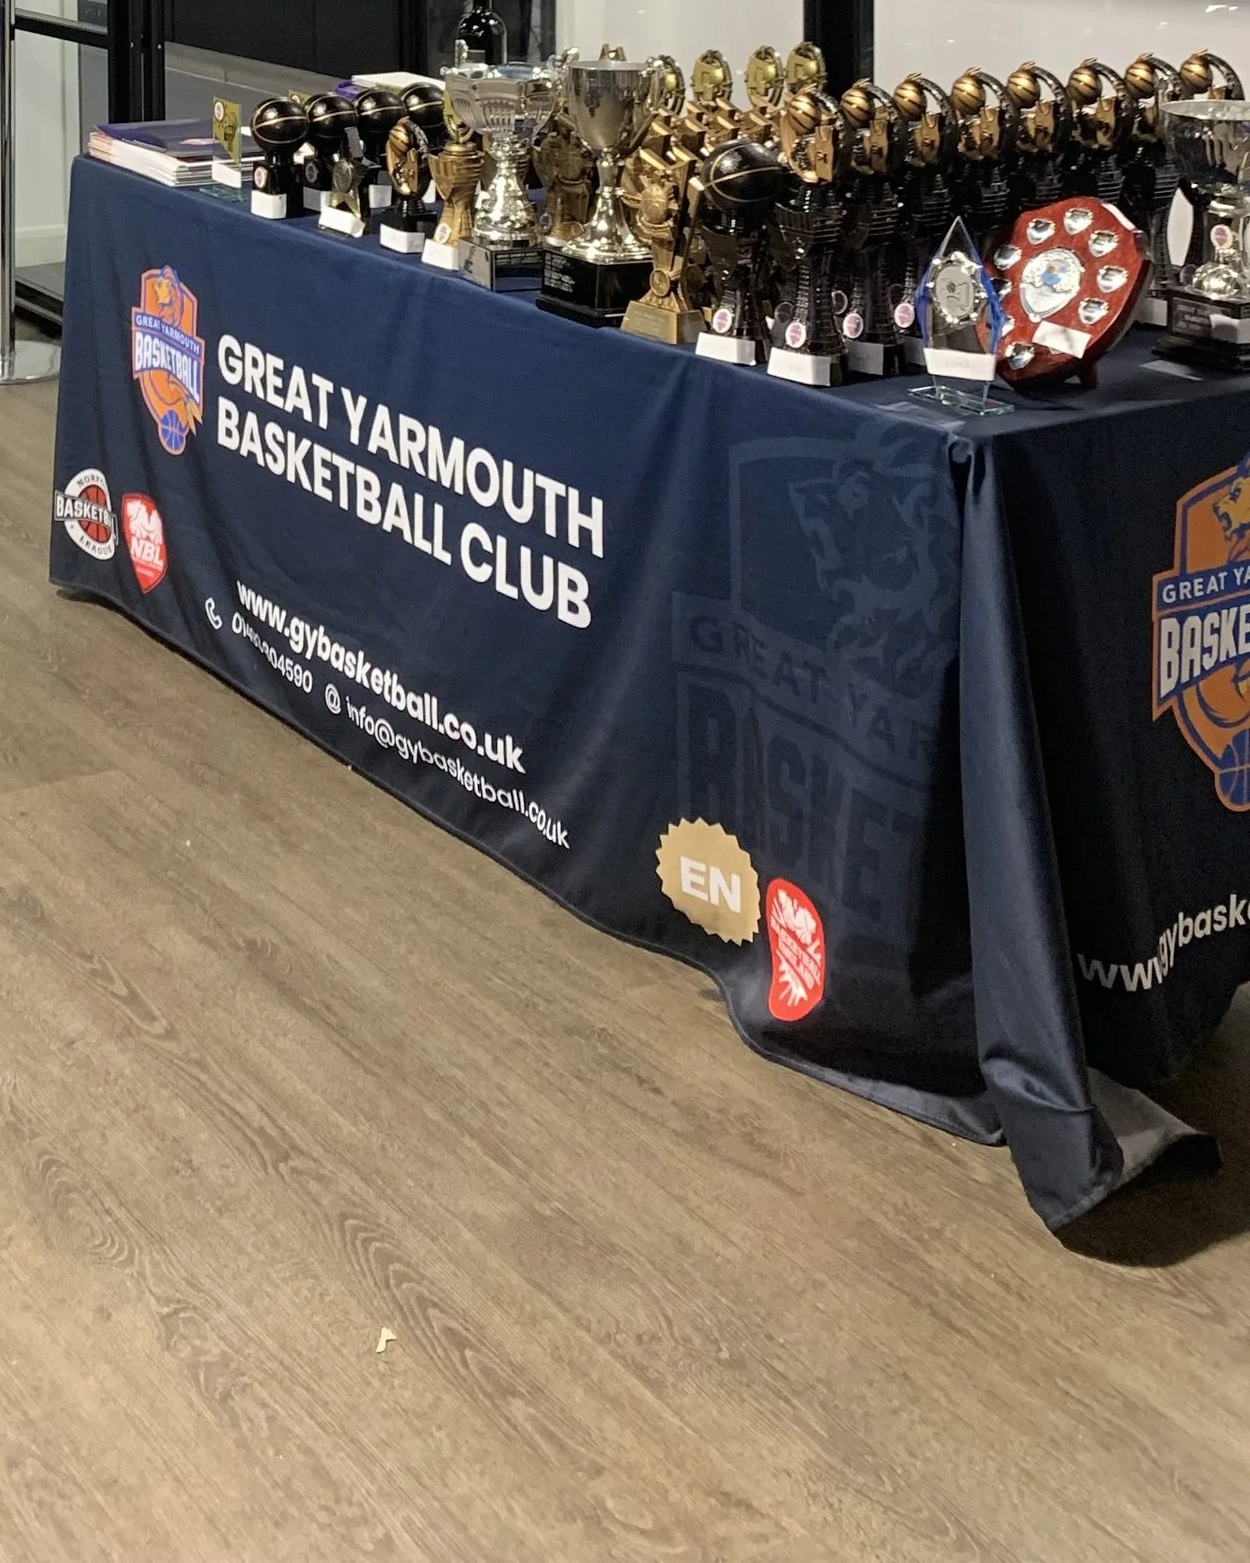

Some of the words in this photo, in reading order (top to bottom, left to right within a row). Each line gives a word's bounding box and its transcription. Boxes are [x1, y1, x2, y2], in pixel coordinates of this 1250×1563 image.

[135, 331, 200, 402] BASKETBALL
[161, 323, 200, 355] YARMOUTH
[218, 334, 334, 430] GREAT
[341, 387, 603, 559] YARMOUTH
[217, 396, 452, 566] BASKETBALL
[461, 522, 592, 629] CLUB
[131, 537, 164, 566] NBL
[1161, 571, 1228, 604] GREAT
[236, 580, 527, 775] www.gybasketball.co.uk
[345, 695, 571, 850] info@gybasketball.co.uk
[679, 854, 742, 915] EN
